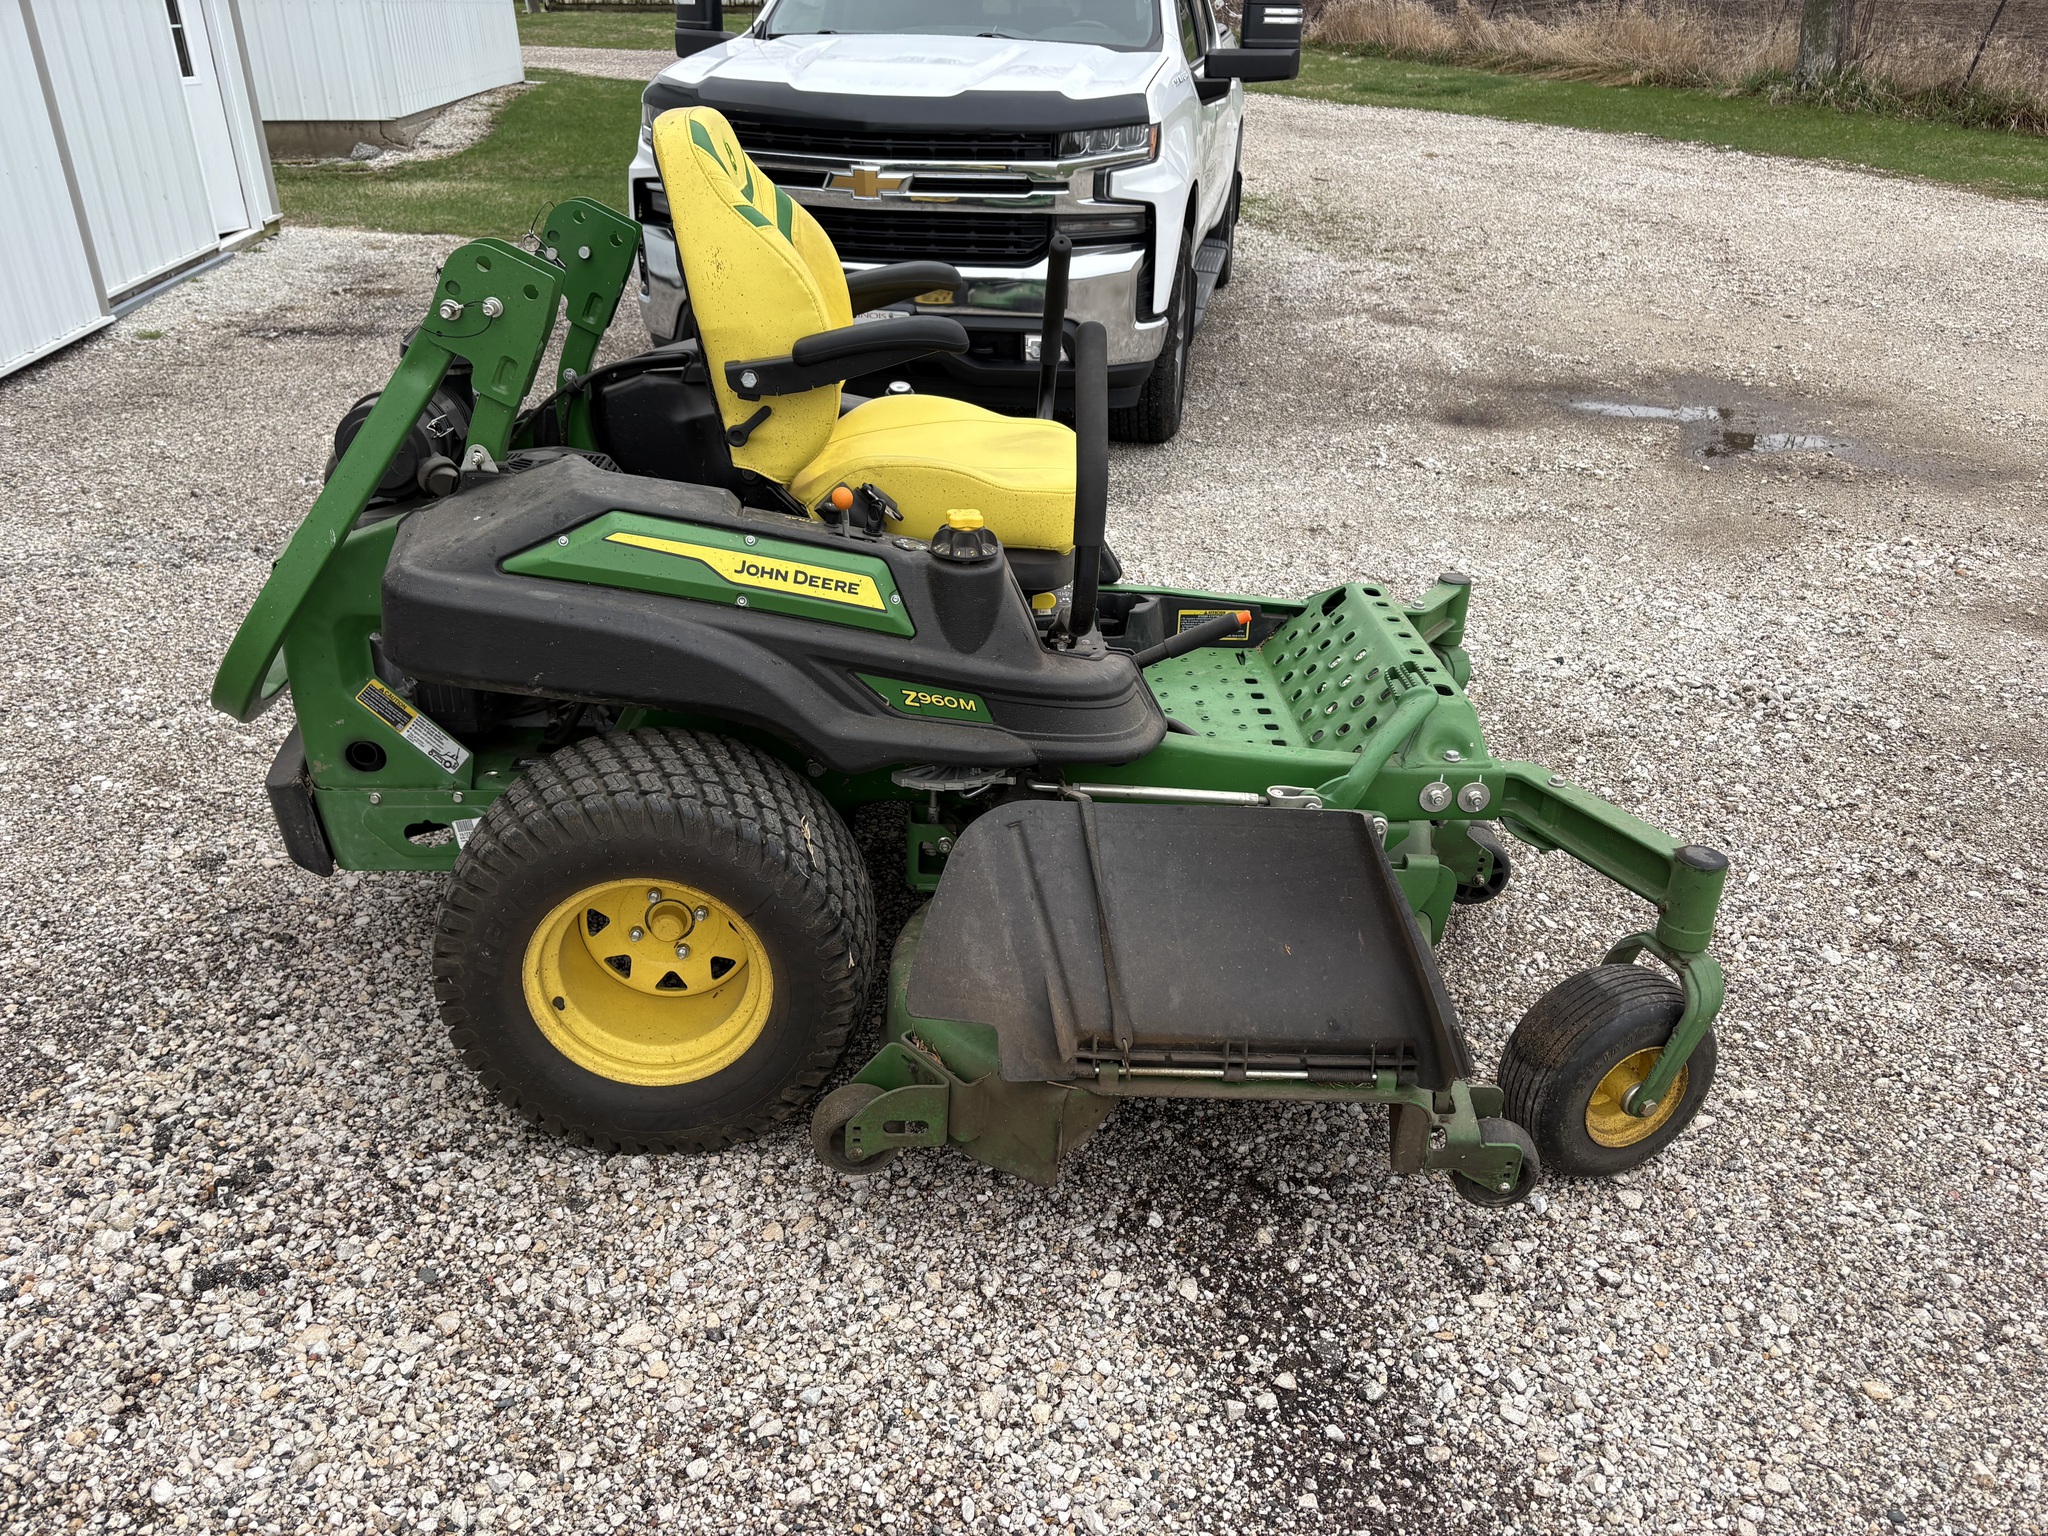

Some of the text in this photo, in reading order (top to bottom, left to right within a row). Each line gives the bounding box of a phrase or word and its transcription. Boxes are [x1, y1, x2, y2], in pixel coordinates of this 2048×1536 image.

[734, 560, 860, 595] JOHN DEERE
[385, 690, 407, 709] CAUTION
[901, 689, 977, 712] Z960M
